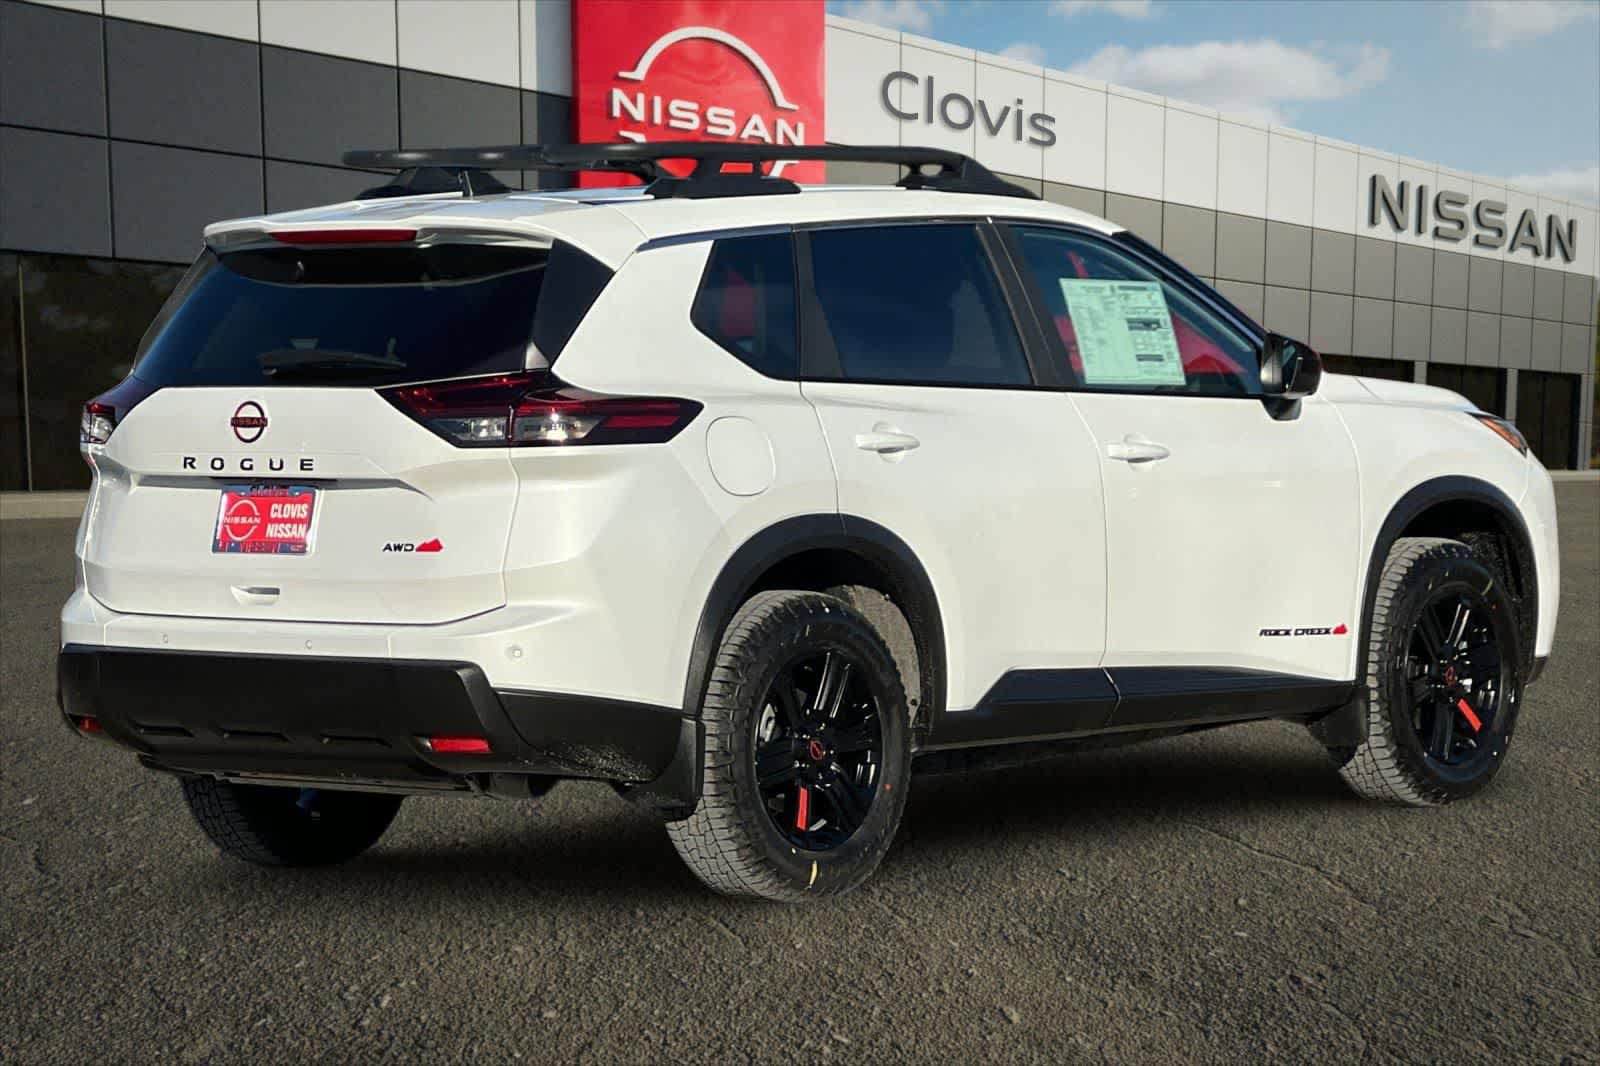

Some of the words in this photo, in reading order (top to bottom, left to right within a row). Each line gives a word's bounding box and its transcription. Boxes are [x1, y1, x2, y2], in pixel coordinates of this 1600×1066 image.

[611, 88, 805, 146] NISSAN
[881, 71, 1057, 147] Clovis
[1368, 173, 1578, 264] NISSAN
[231, 417, 267, 426] NISSAN
[183, 456, 314, 472] ROGUE
[270, 503, 308, 519] CLOVIS
[224, 515, 261, 524] NISSAN
[265, 523, 307, 538] NISSAN
[382, 543, 415, 552] AWD
